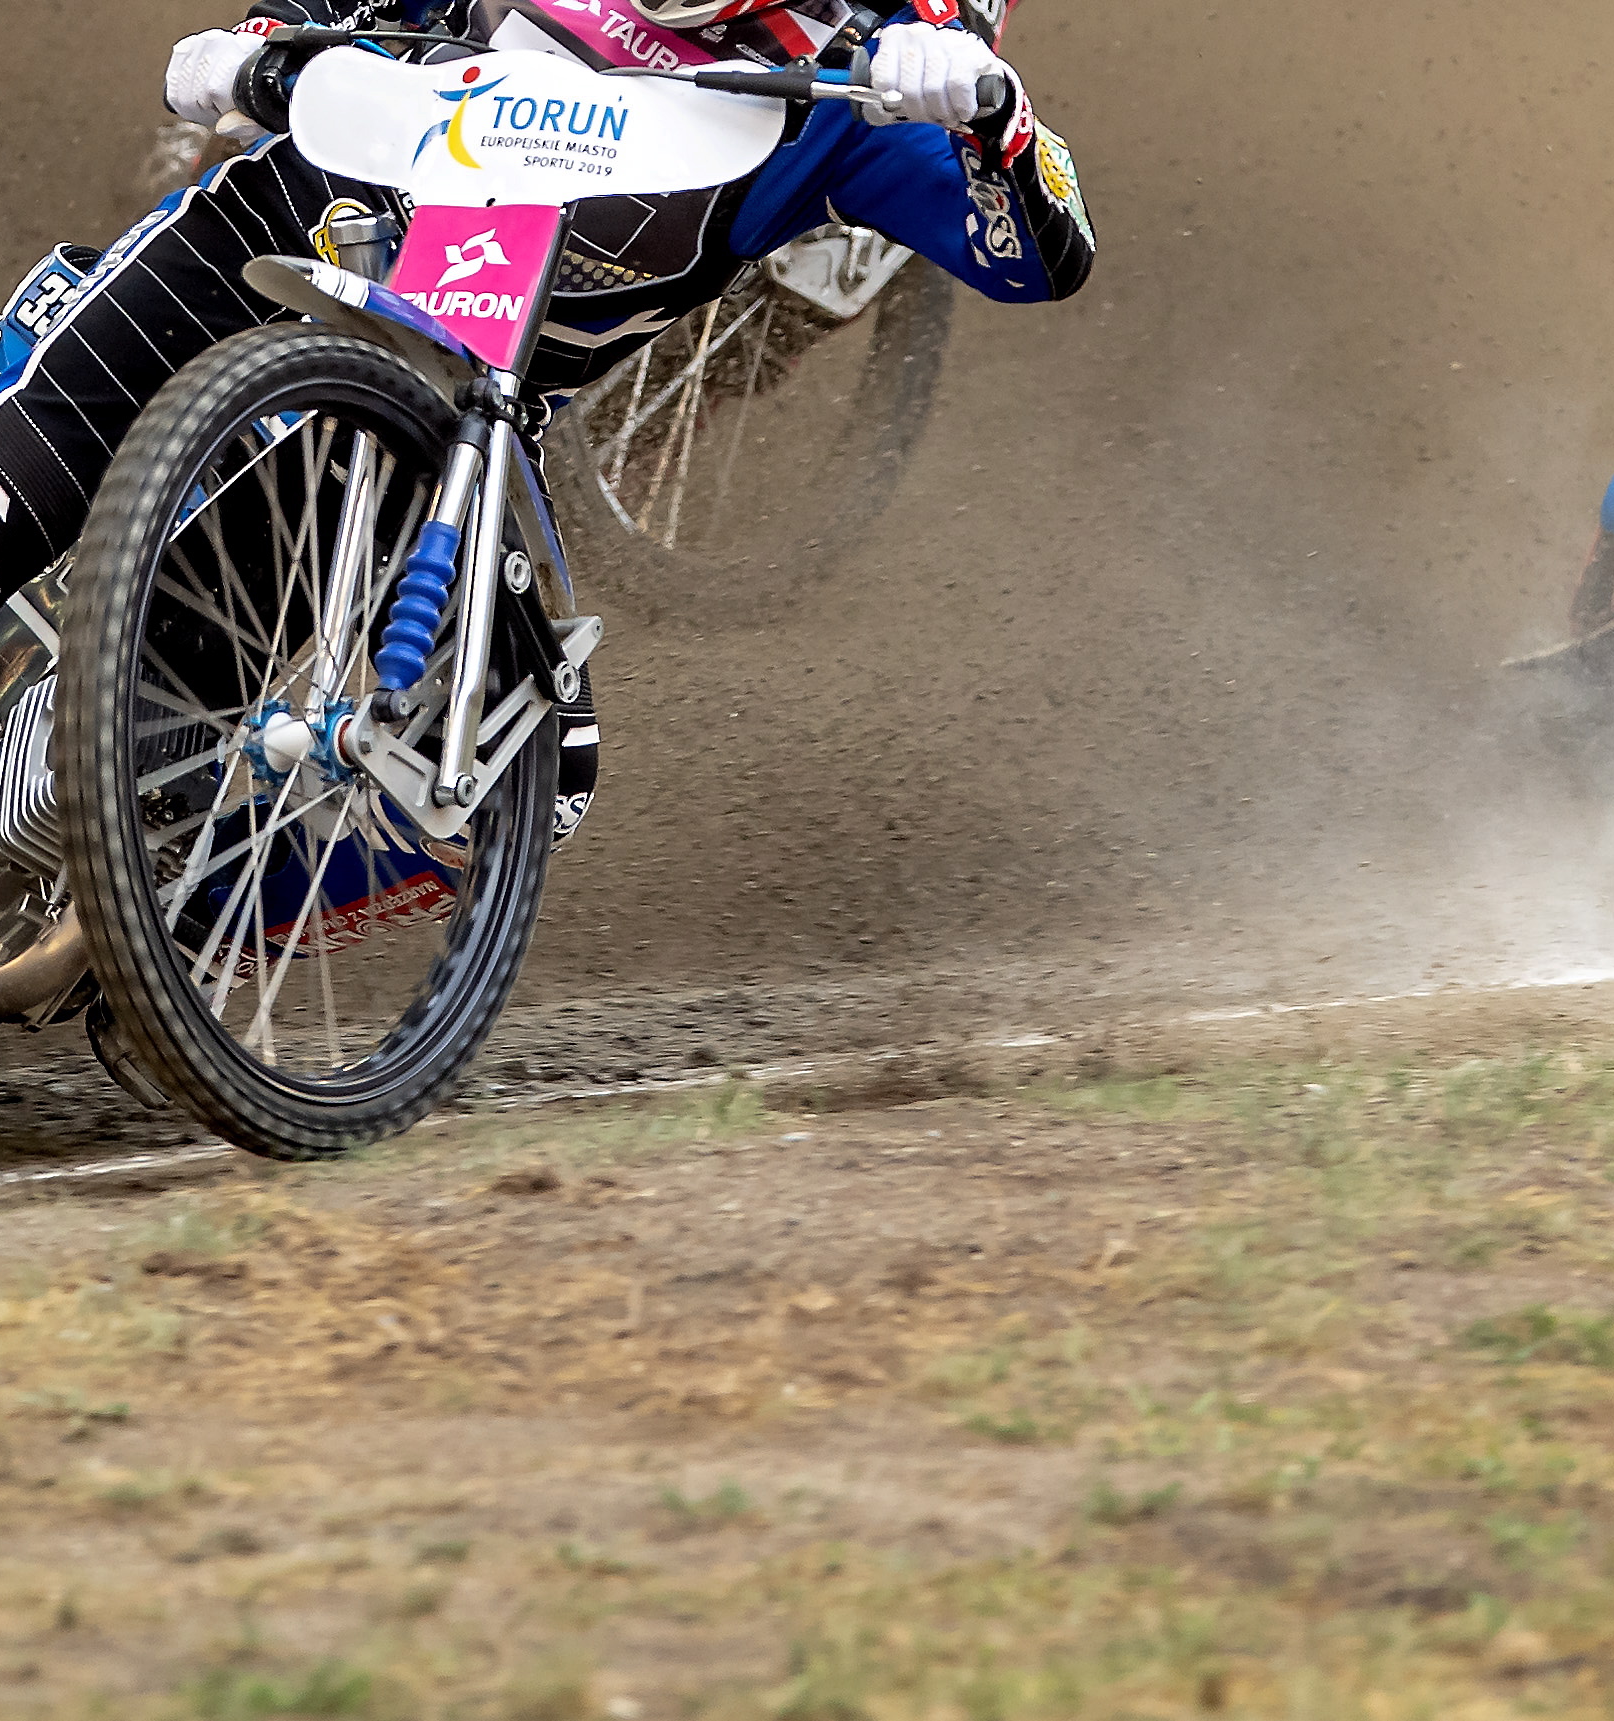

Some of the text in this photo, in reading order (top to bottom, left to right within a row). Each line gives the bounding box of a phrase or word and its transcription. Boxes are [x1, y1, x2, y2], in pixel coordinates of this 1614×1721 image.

[599, 9, 692, 73] TAUR
[493, 95, 629, 141] TORUŃ
[481, 135, 618, 159] EUROPEJSKIE MIASTO
[523, 155, 613, 177] SPORTU 2019
